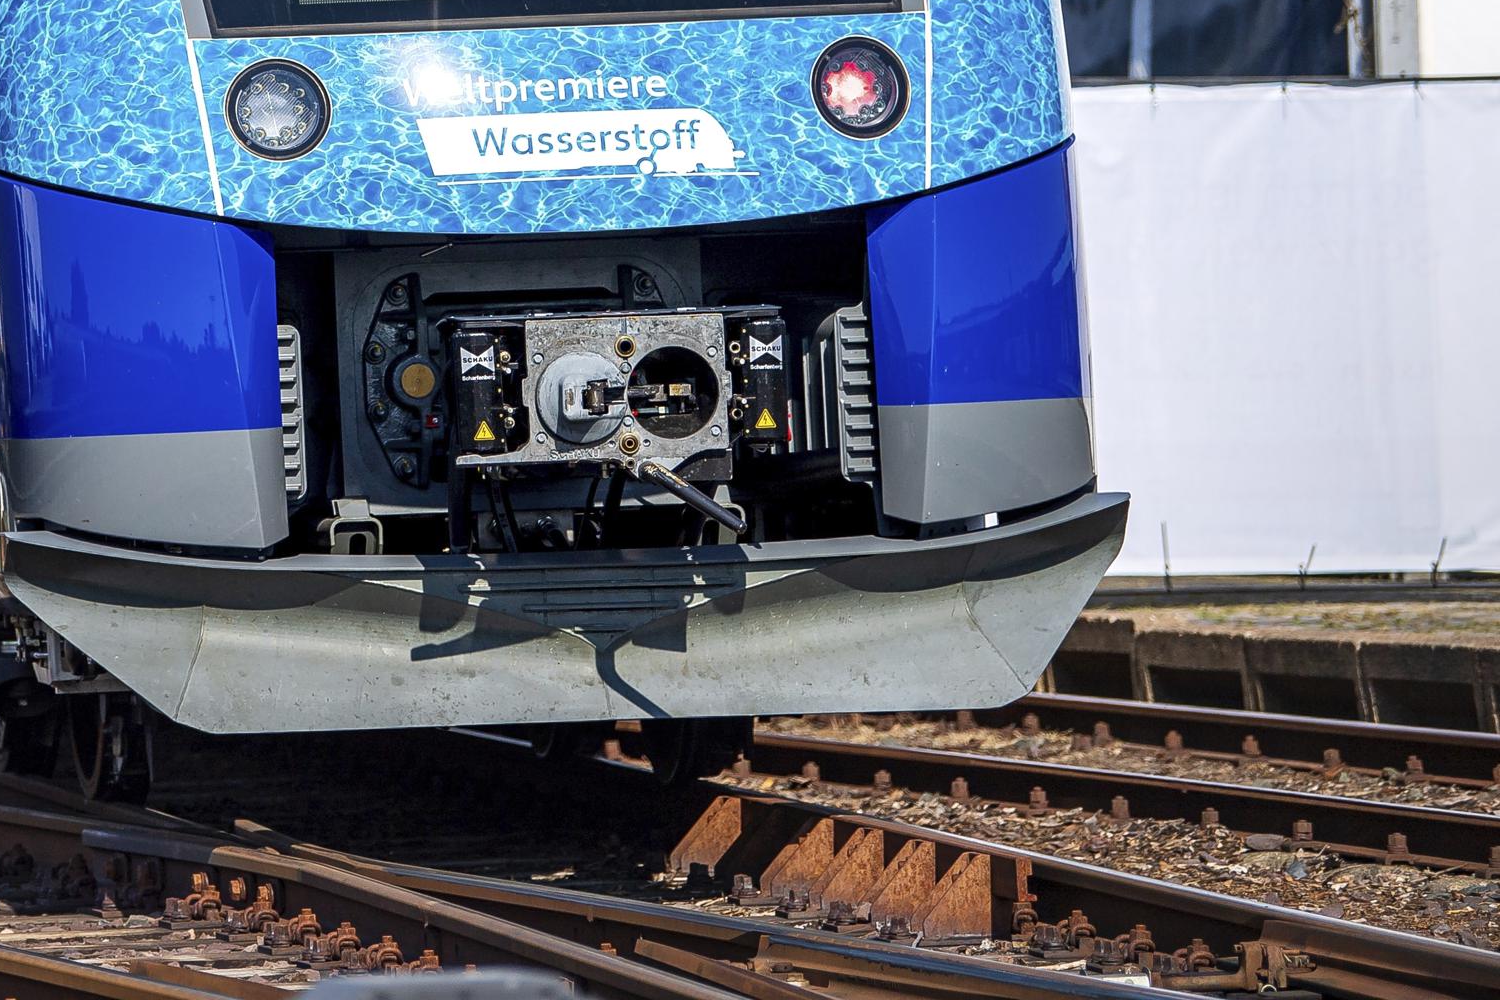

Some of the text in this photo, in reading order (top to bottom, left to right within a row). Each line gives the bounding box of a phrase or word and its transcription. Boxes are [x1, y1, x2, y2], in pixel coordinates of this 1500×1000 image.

[403, 69, 667, 112] Wltpremiere
[471, 119, 701, 157] Wasserstoff
[462, 355, 493, 364] SCHAKU
[751, 344, 781, 352] SCHAKU
